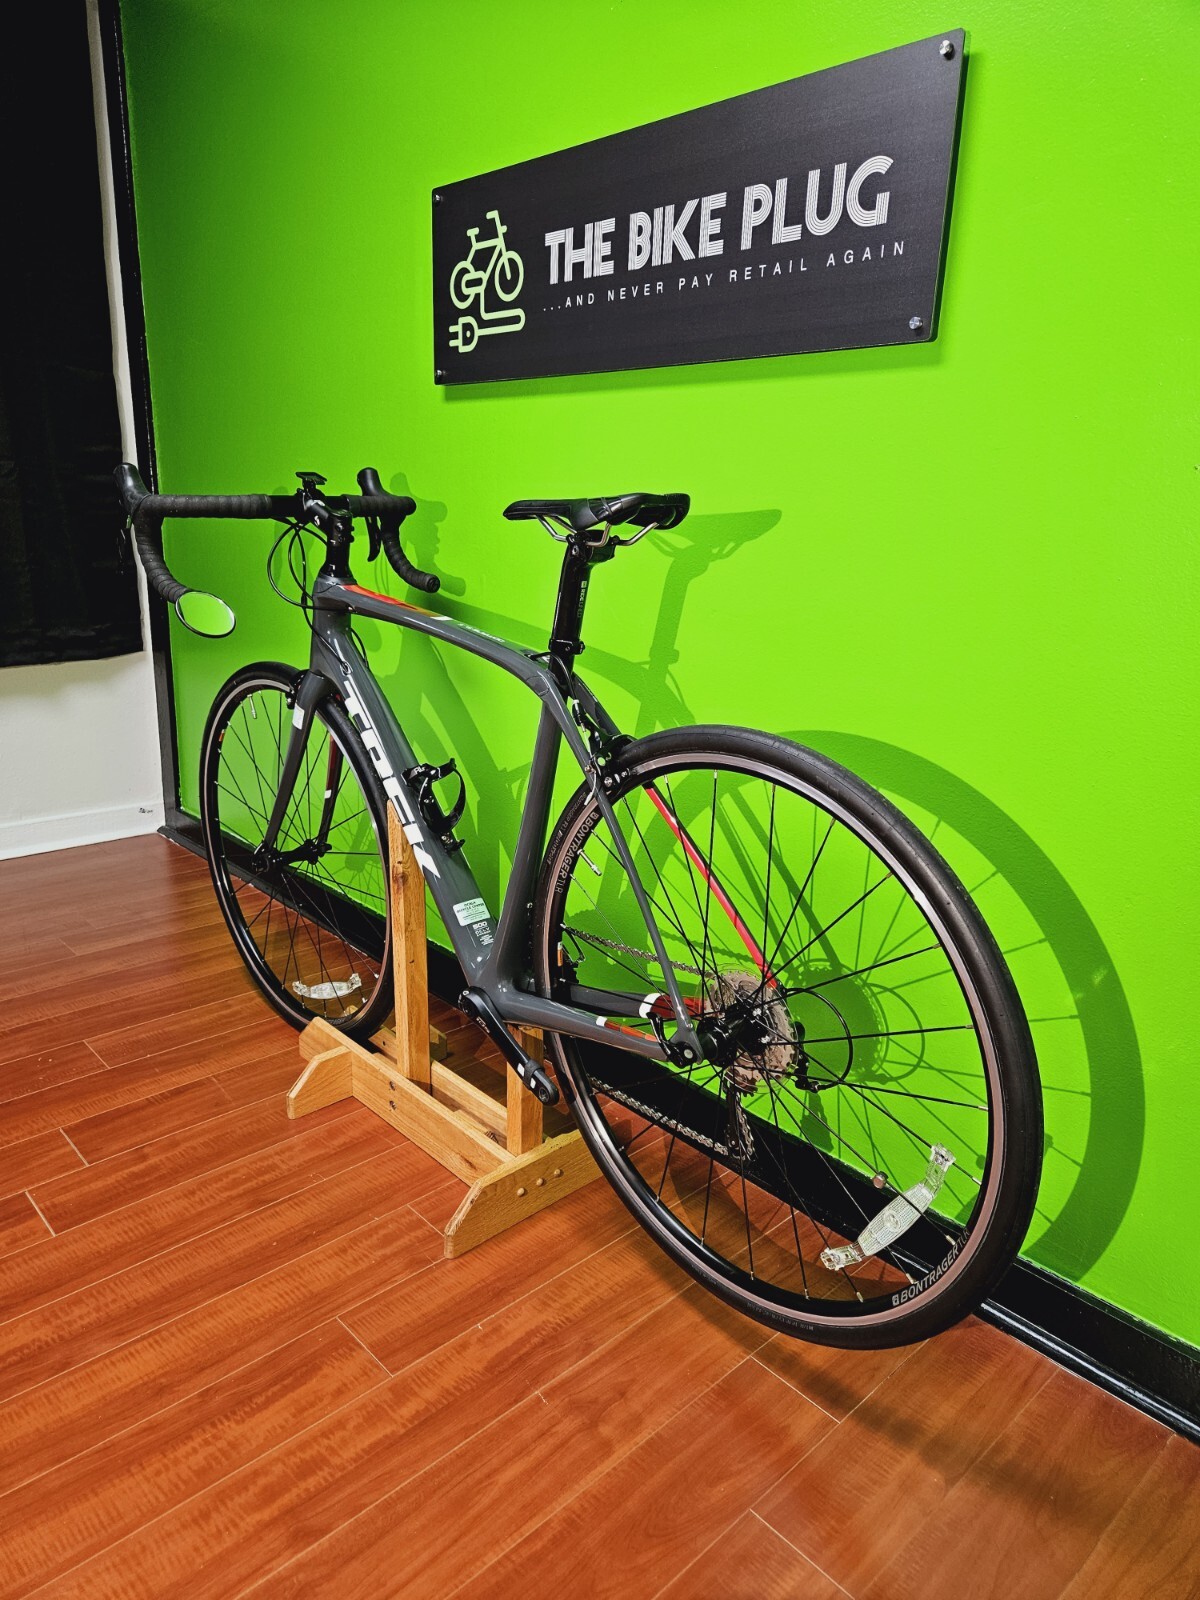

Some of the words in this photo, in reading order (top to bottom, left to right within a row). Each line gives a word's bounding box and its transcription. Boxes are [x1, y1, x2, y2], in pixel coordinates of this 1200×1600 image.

[544, 217, 616, 285] THE
[627, 191, 728, 271] BIKE
[740, 154, 895, 251] PLUG
[607, 281, 664, 302] NEVER
[678, 272, 713, 291] PAY
[729, 257, 808, 283] RETAIL
[826, 240, 905, 268] AGAIN
[343, 680, 441, 880] TREK
[560, 817, 594, 879] BONTRAGER
[900, 1244, 960, 1303] BONTRAGER
